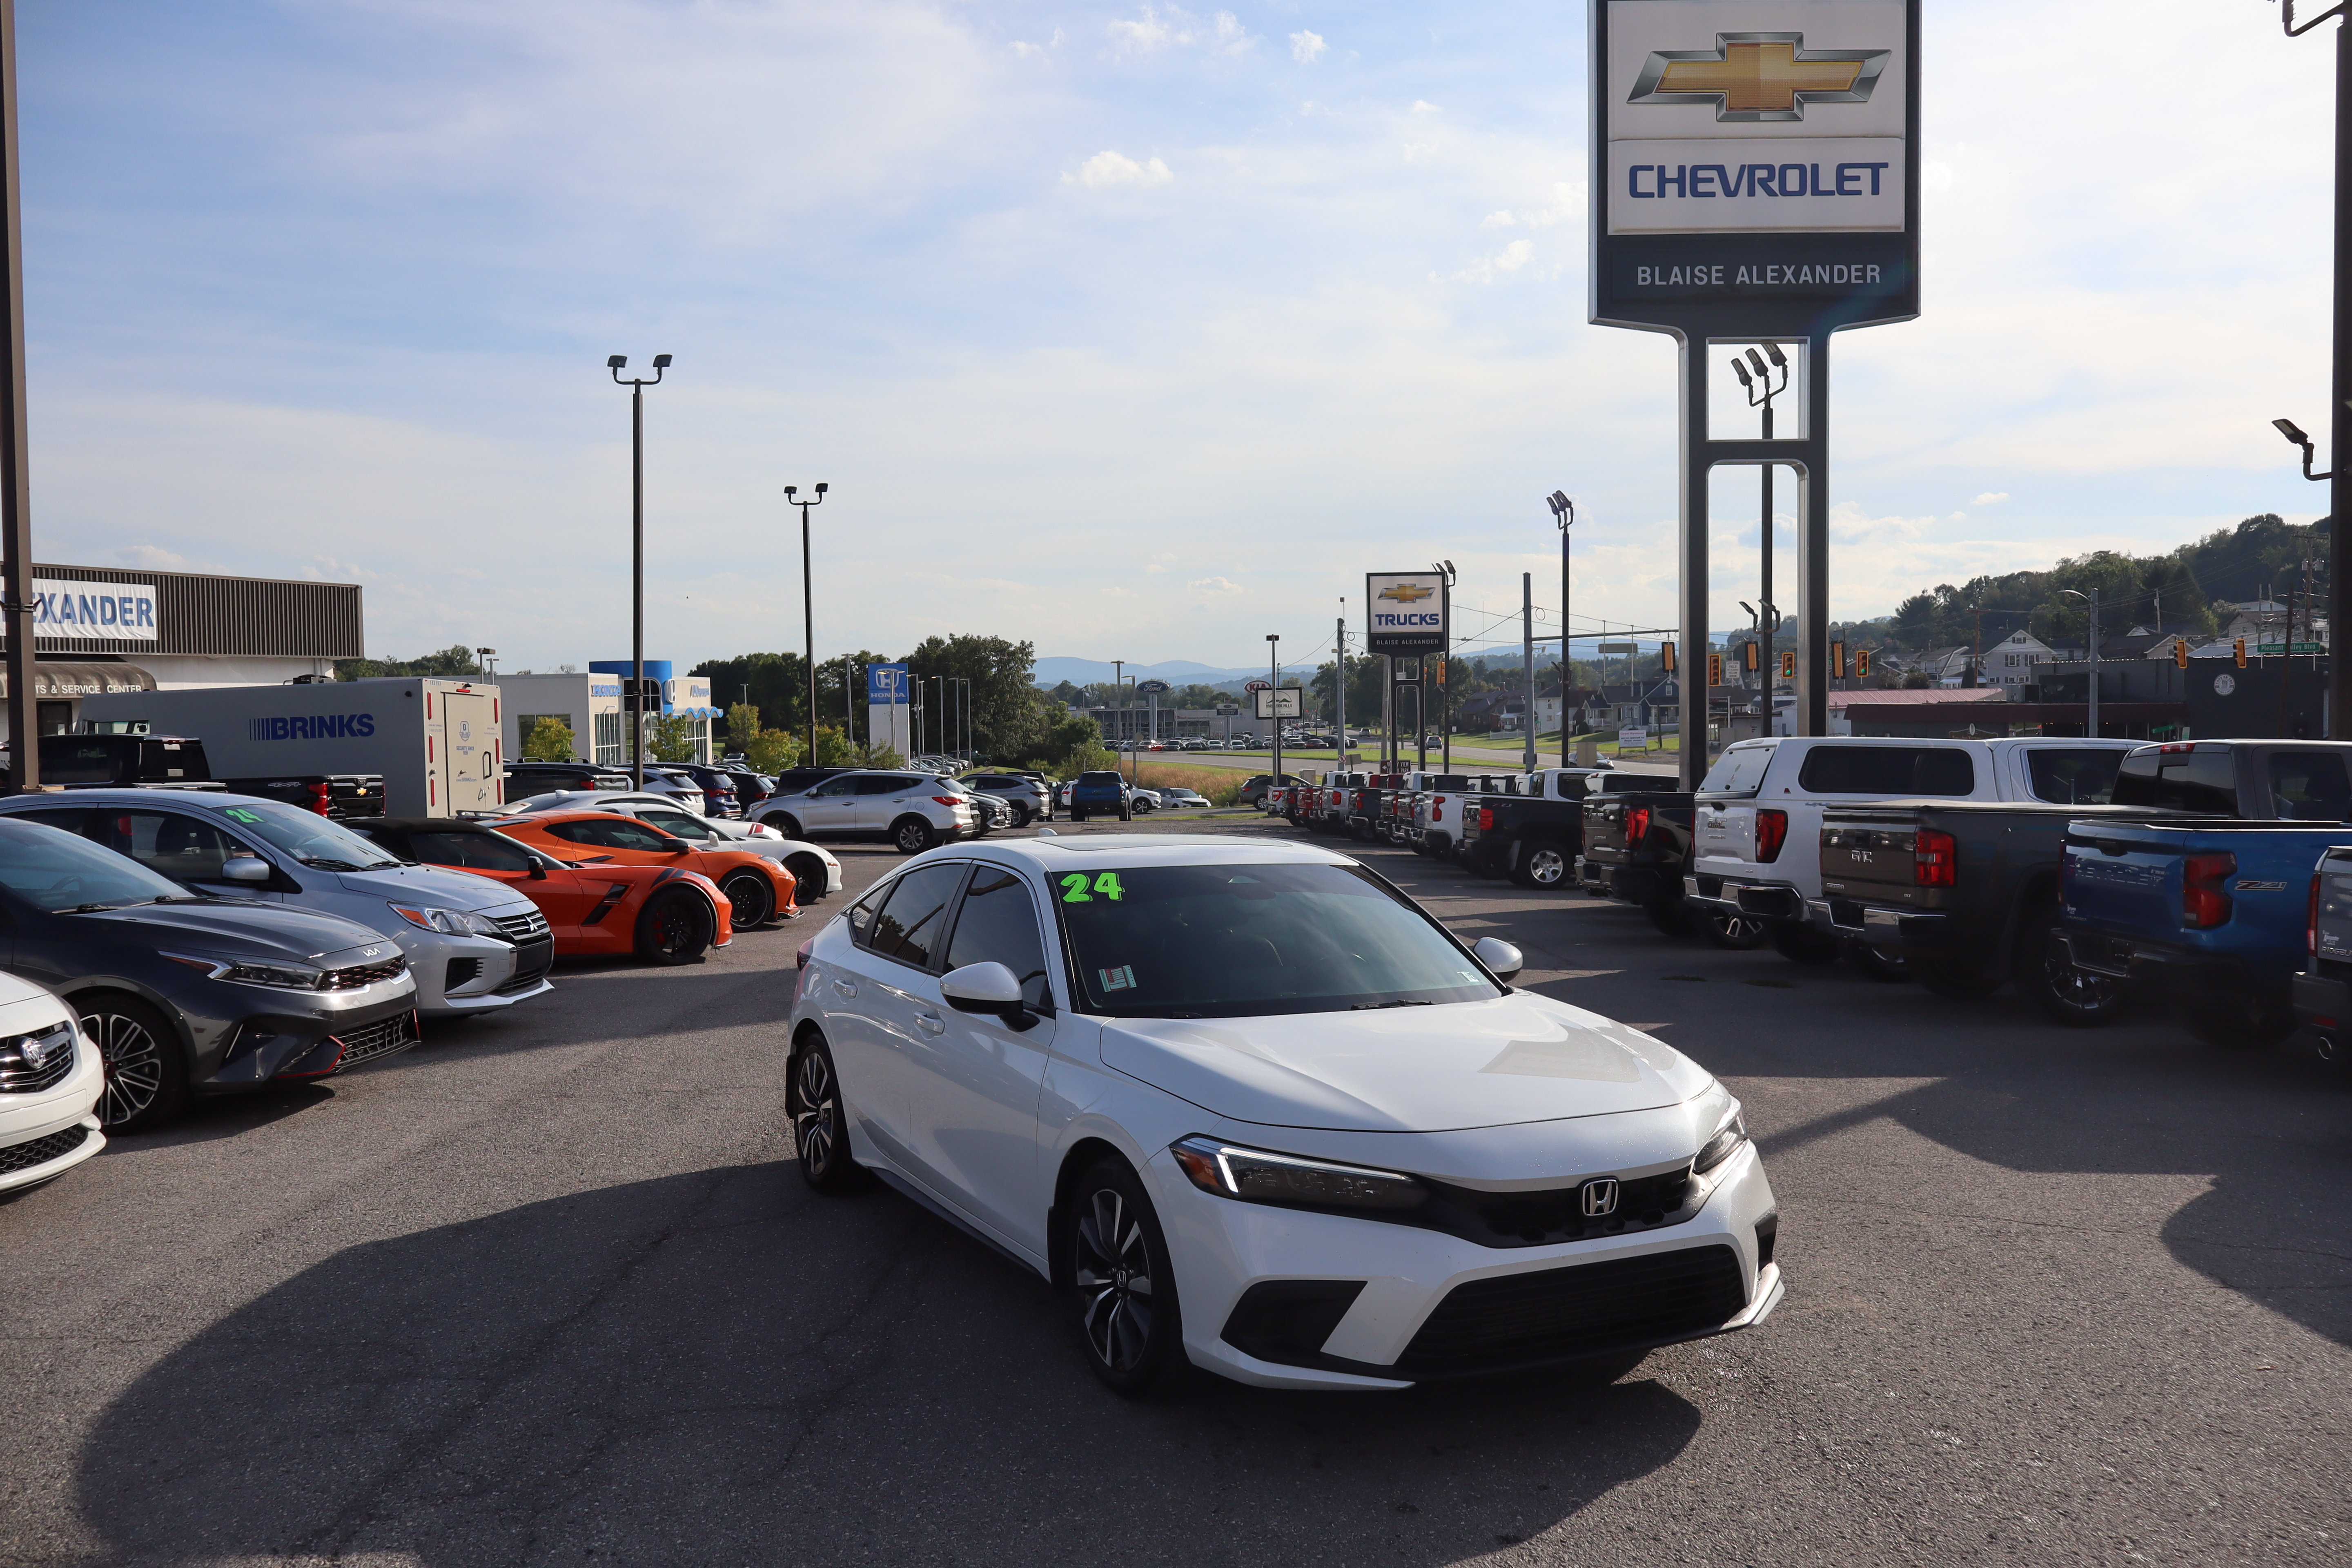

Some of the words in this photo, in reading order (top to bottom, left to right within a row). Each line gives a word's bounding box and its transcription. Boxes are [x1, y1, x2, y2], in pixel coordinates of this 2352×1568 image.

[1629, 162, 1889, 198] CHEVROLET
[1637, 265, 1725, 286] BLAISE
[1735, 264, 1881, 285] ALEXANDER
[1375, 613, 1439, 626] TRUCKS
[35, 685, 47, 694] TS
[51, 685, 58, 694] &
[62, 685, 101, 694] SERVICE
[107, 685, 142, 693] CENTER
[591, 684, 622, 697] HONDA
[1143, 683, 1162, 691] Ford
[270, 713, 375, 740] BRINKS
[225, 808, 268, 823] 24
[1707, 817, 1727, 829] GMC
[1851, 850, 1872, 863] GMC
[1060, 872, 1126, 903] 24
[2234, 880, 2287, 891] Z71
